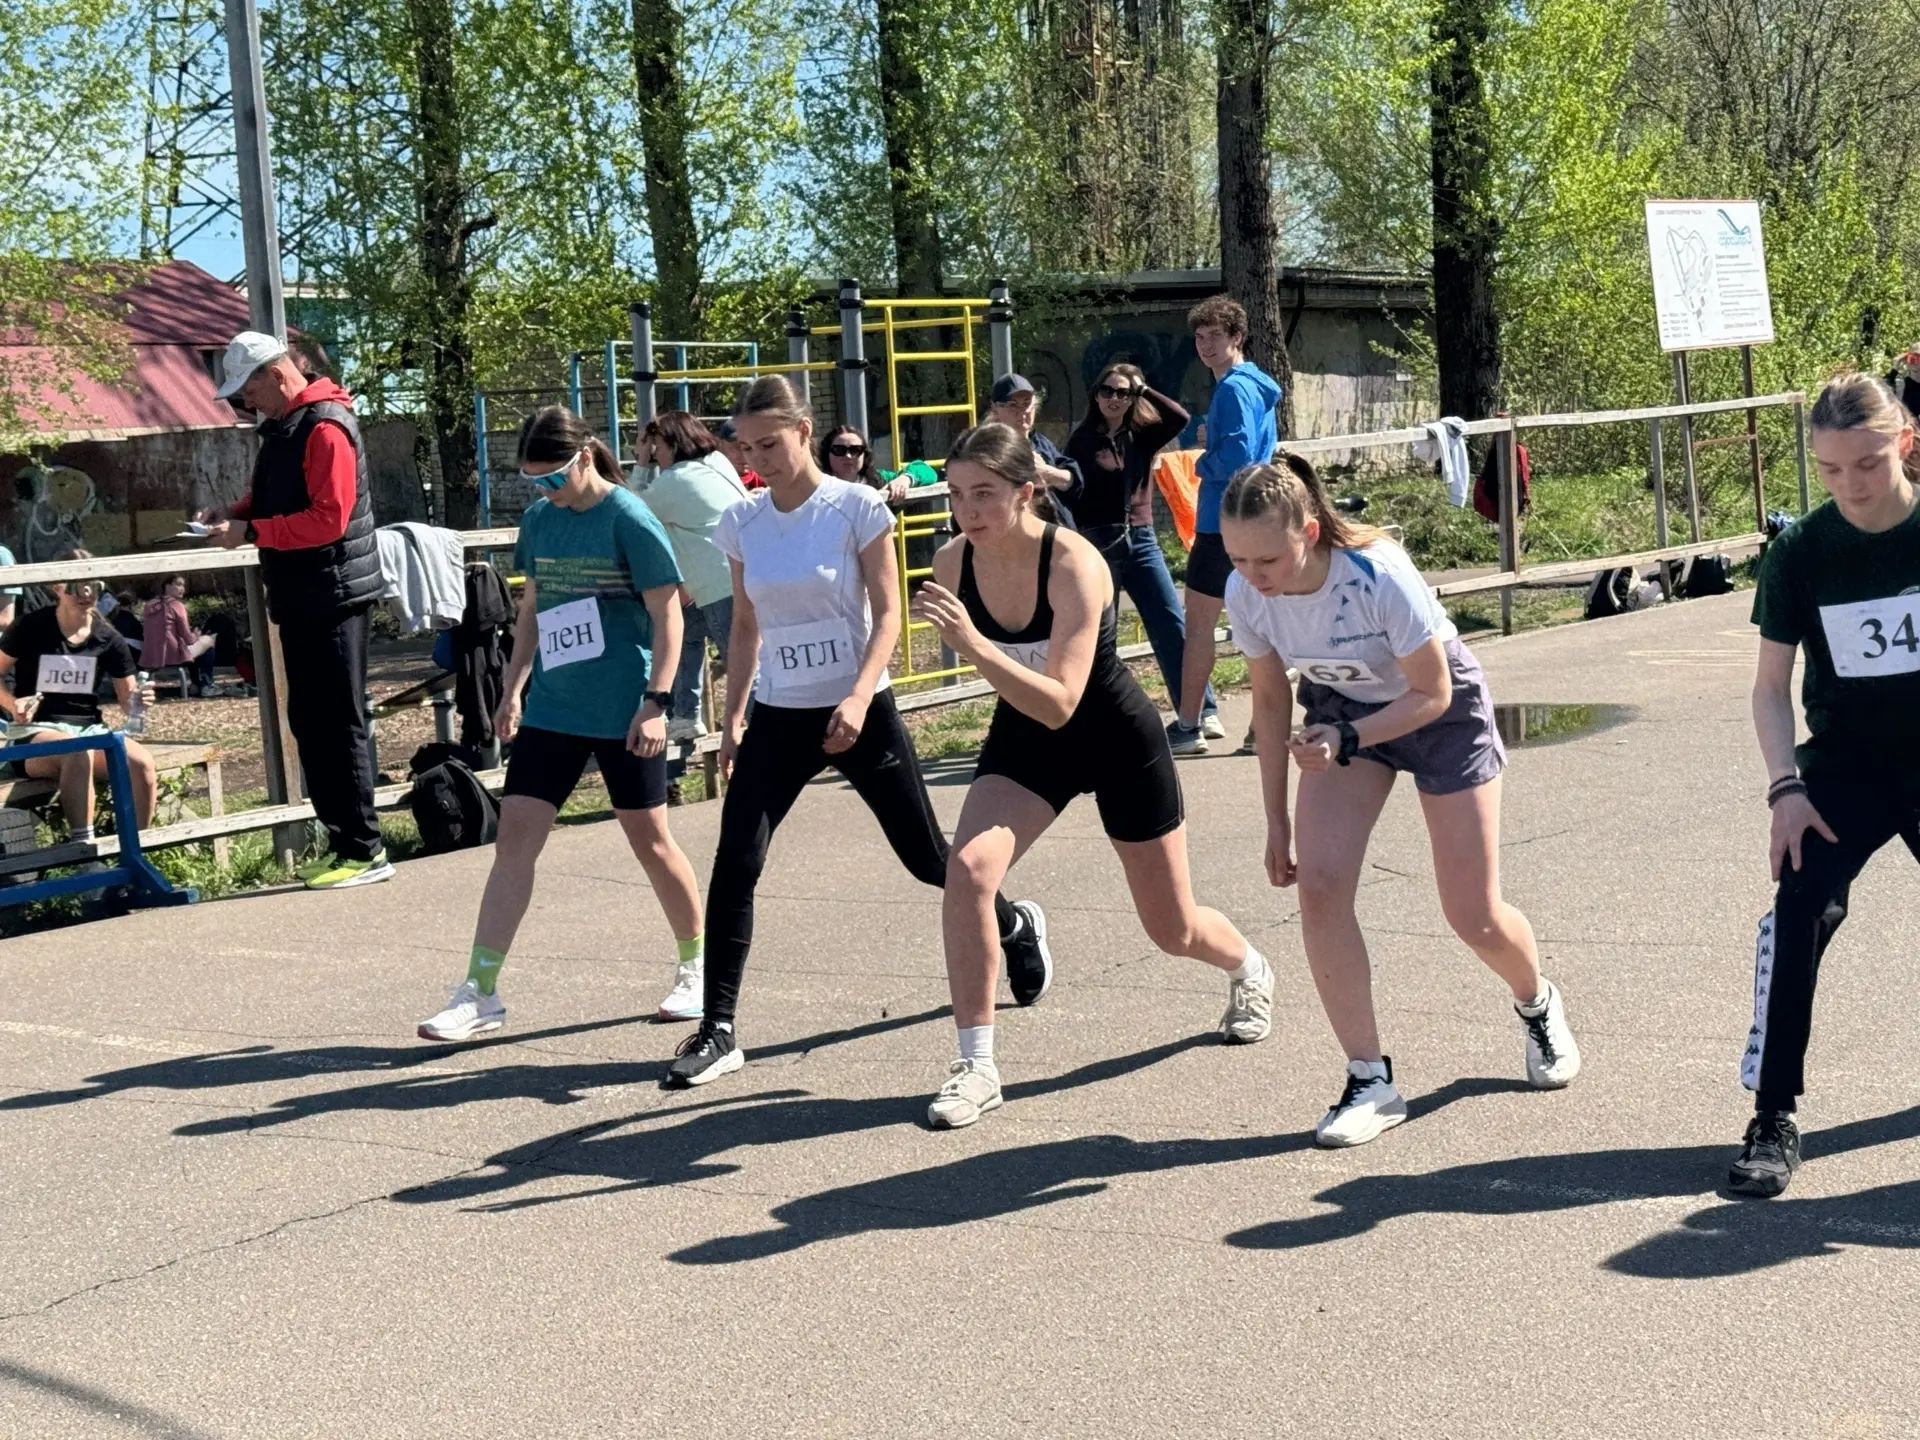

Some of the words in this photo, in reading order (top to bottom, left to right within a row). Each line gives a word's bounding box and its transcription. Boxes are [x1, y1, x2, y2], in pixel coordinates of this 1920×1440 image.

[546, 621, 595, 655] лен
[1859, 612, 1920, 659] 34
[779, 638, 841, 670] ВТЛ
[44, 669, 89, 685] лен
[1308, 664, 1372, 682] 62
